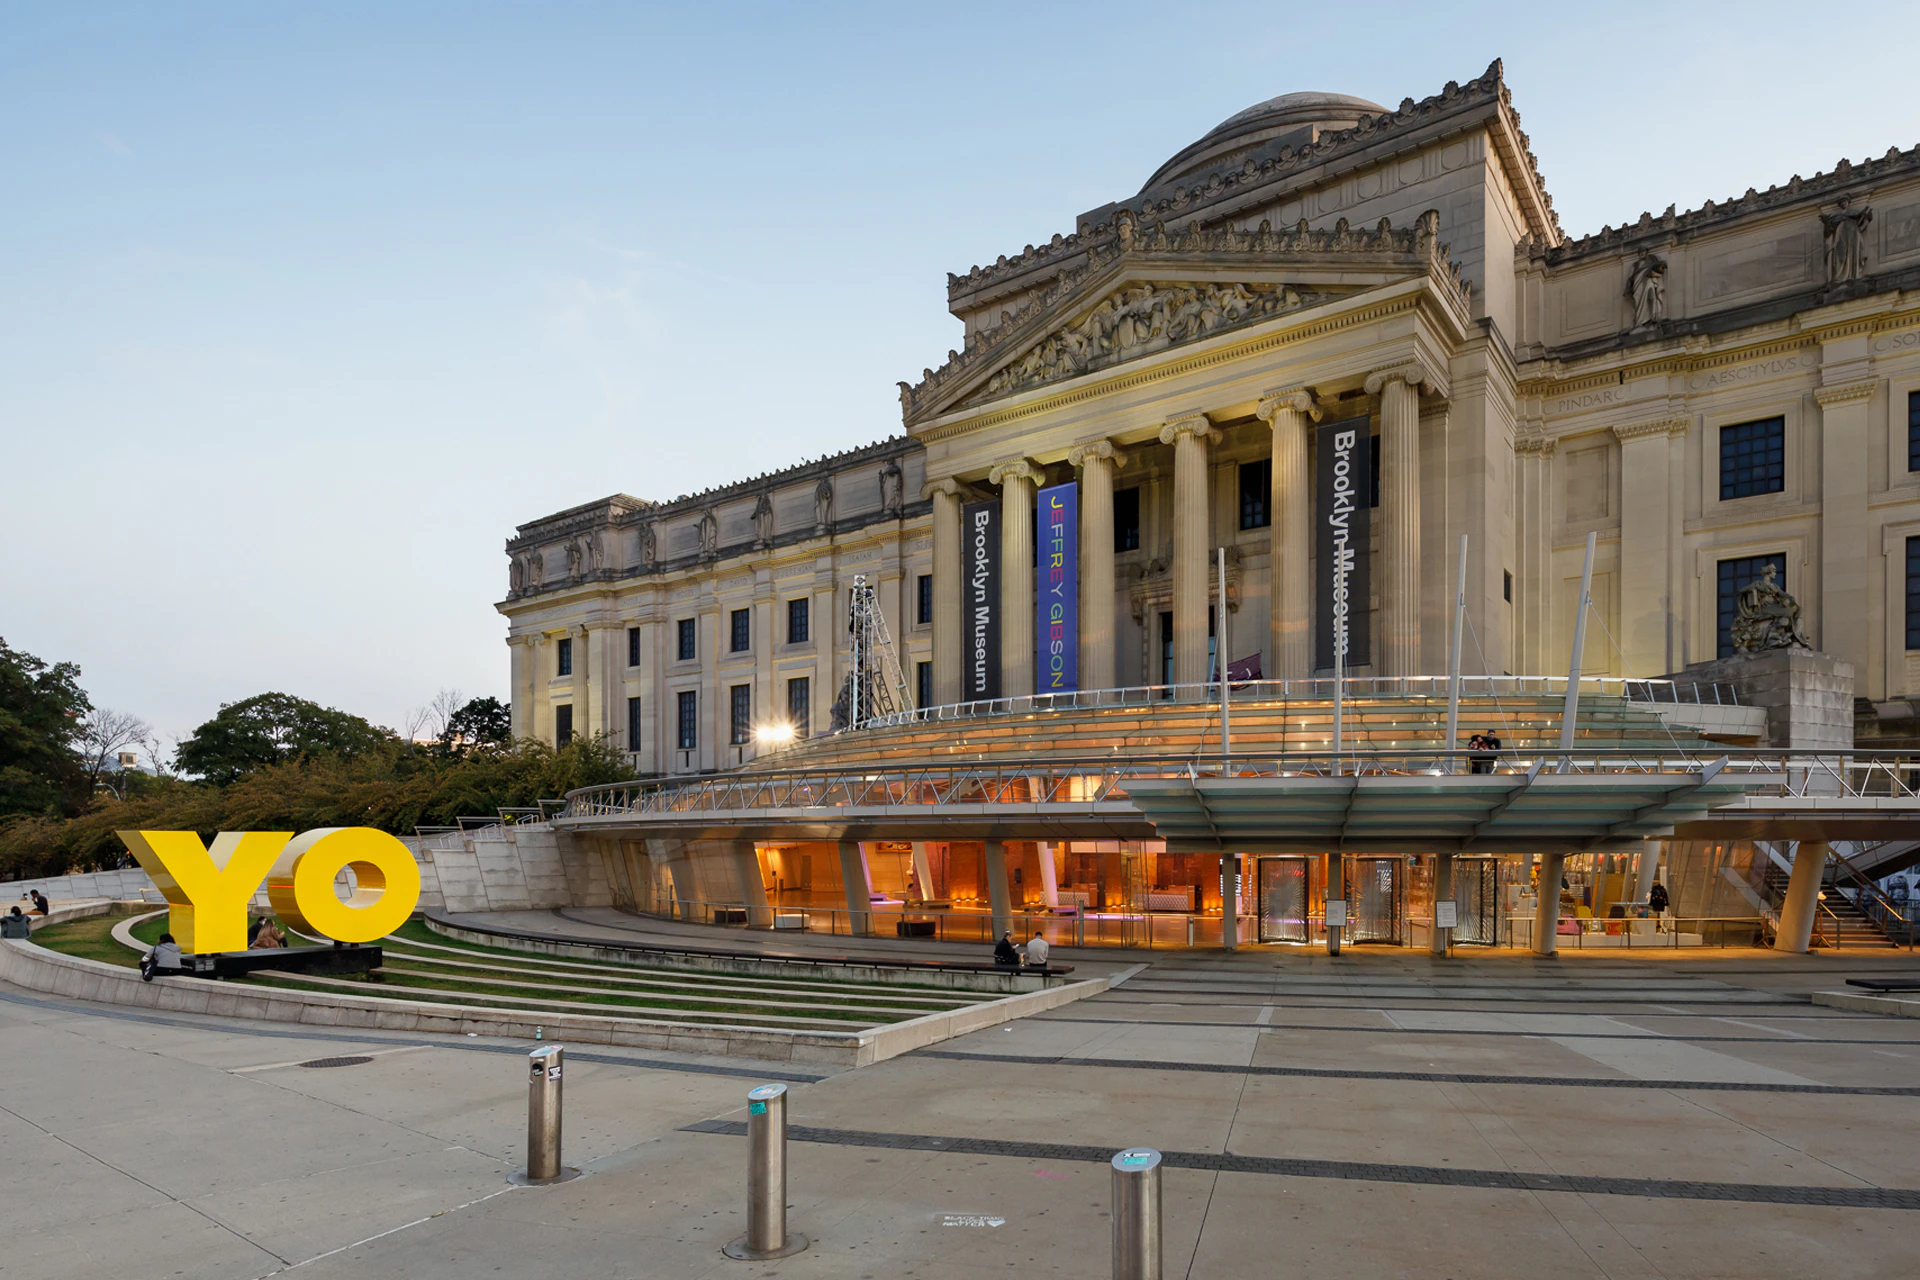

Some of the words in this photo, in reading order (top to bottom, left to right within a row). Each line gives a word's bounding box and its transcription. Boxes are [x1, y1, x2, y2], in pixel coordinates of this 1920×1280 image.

[1707, 357, 1797, 387] AESCHYLVS
[1893, 331, 1920, 349] SO
[1558, 391, 1613, 412] PINDAR
[1329, 430, 1356, 545] Brooklyn
[972, 510, 990, 602] Brooklyn
[1050, 496, 1064, 597] JEFFREY
[1050, 603, 1064, 687] GIBSON
[1333, 549, 1355, 656] Museum
[975, 606, 990, 693] Museum
[117, 826, 421, 954] YO
